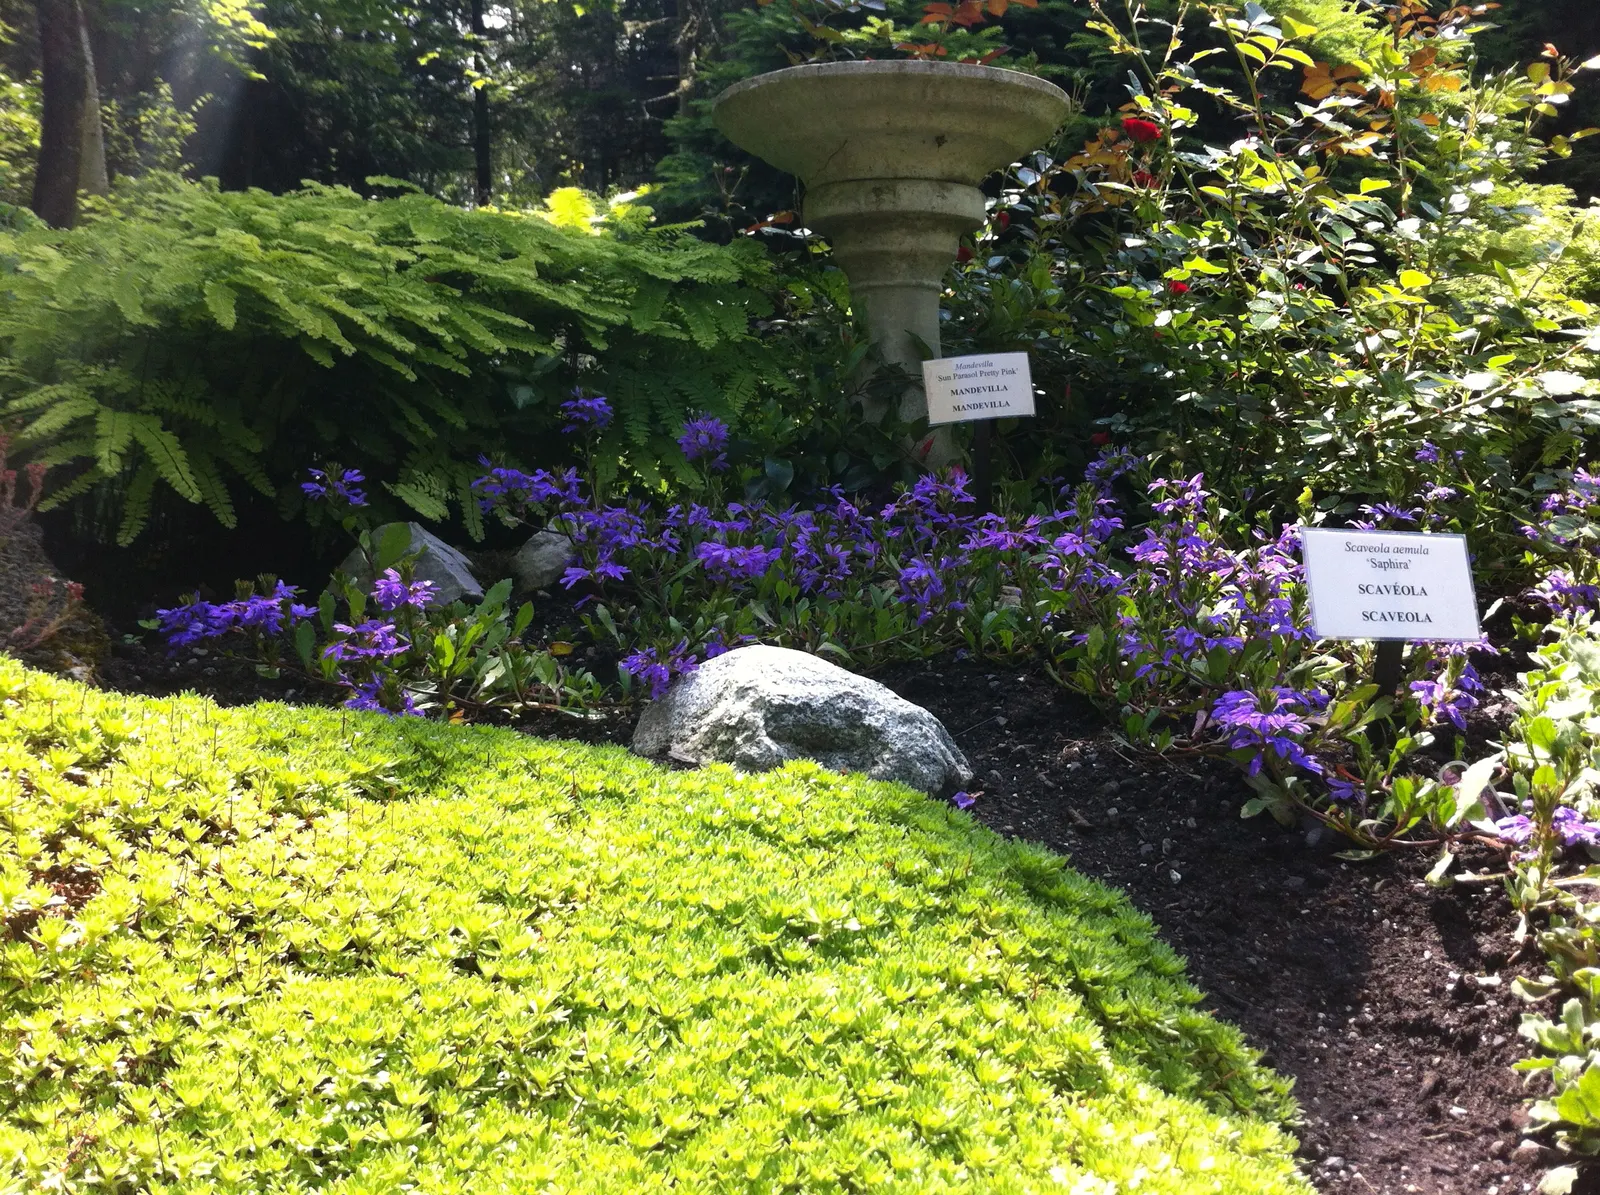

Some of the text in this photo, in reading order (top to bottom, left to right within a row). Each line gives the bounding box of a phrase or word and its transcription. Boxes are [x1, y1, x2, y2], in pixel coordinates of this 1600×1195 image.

[955, 360, 993, 370] Mandevilla
[953, 370, 977, 380] Parasol
[980, 369, 999, 377] Pretty
[950, 385, 1008, 396] MANDEVILLA
[952, 401, 1010, 412] MANDEVILLA
[1345, 541, 1429, 555] Scaveola aemula
[1358, 582, 1428, 596] SCAVÉOLA
[1362, 611, 1432, 623] SCAVEOLA
